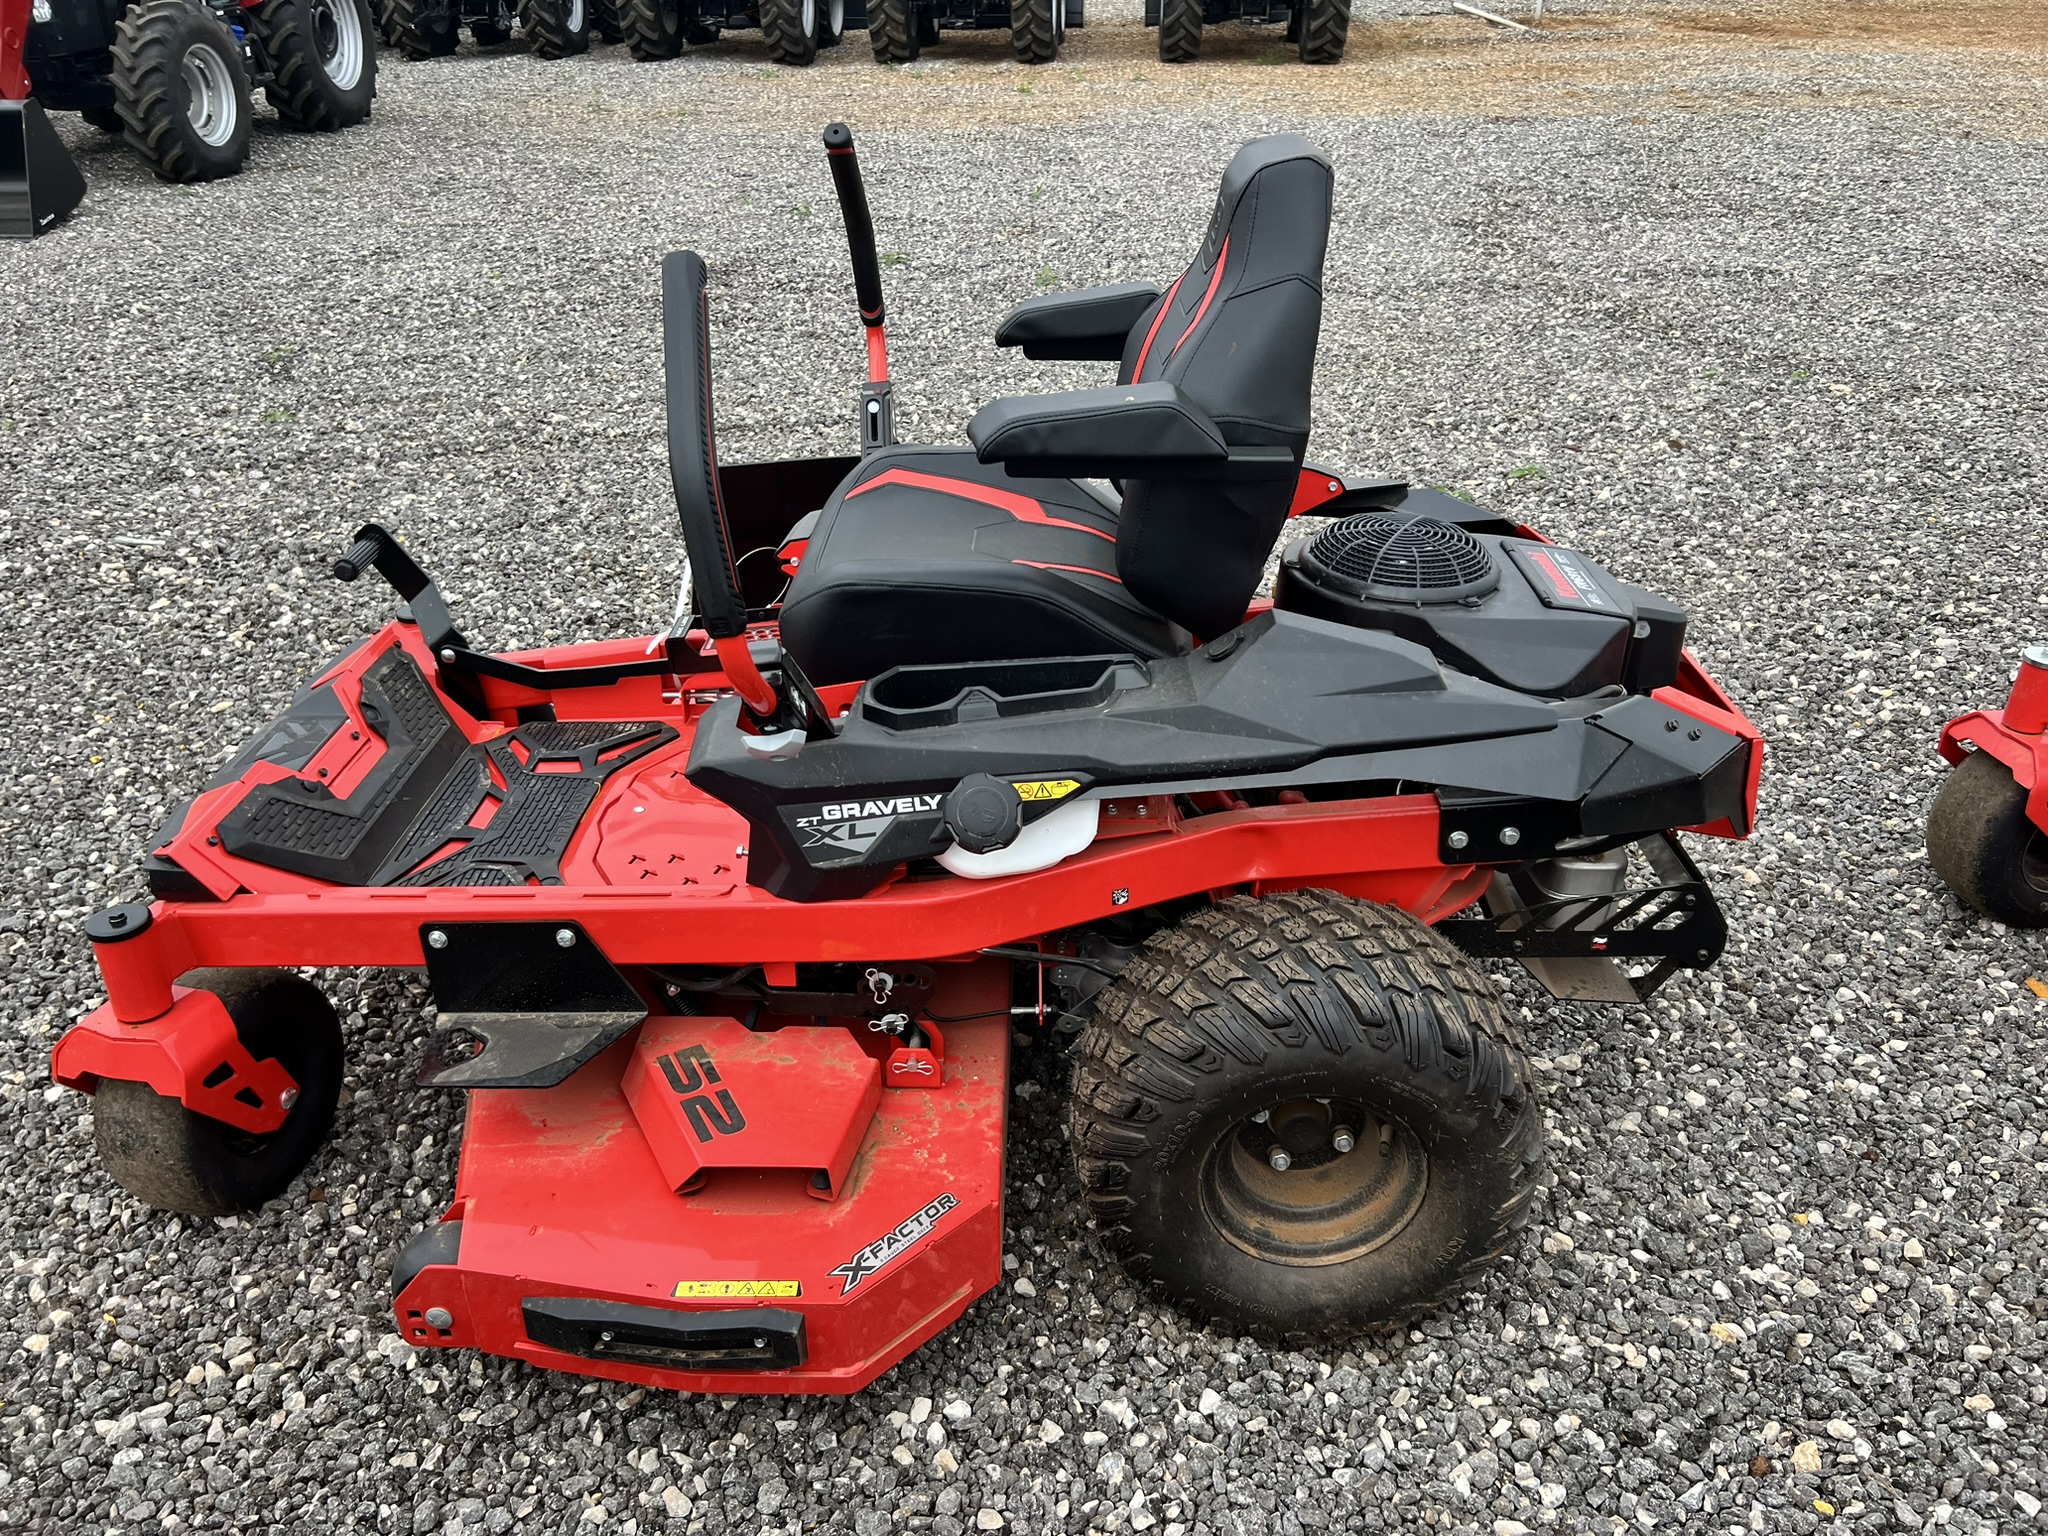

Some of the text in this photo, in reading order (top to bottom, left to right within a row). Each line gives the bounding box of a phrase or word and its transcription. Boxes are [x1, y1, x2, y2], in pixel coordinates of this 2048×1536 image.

[822, 794, 943, 821] GRAVELY
[796, 816, 822, 828] ZT
[803, 823, 877, 848] XL
[656, 1043, 746, 1144] 52
[831, 1193, 956, 1289] X-FACTOR
